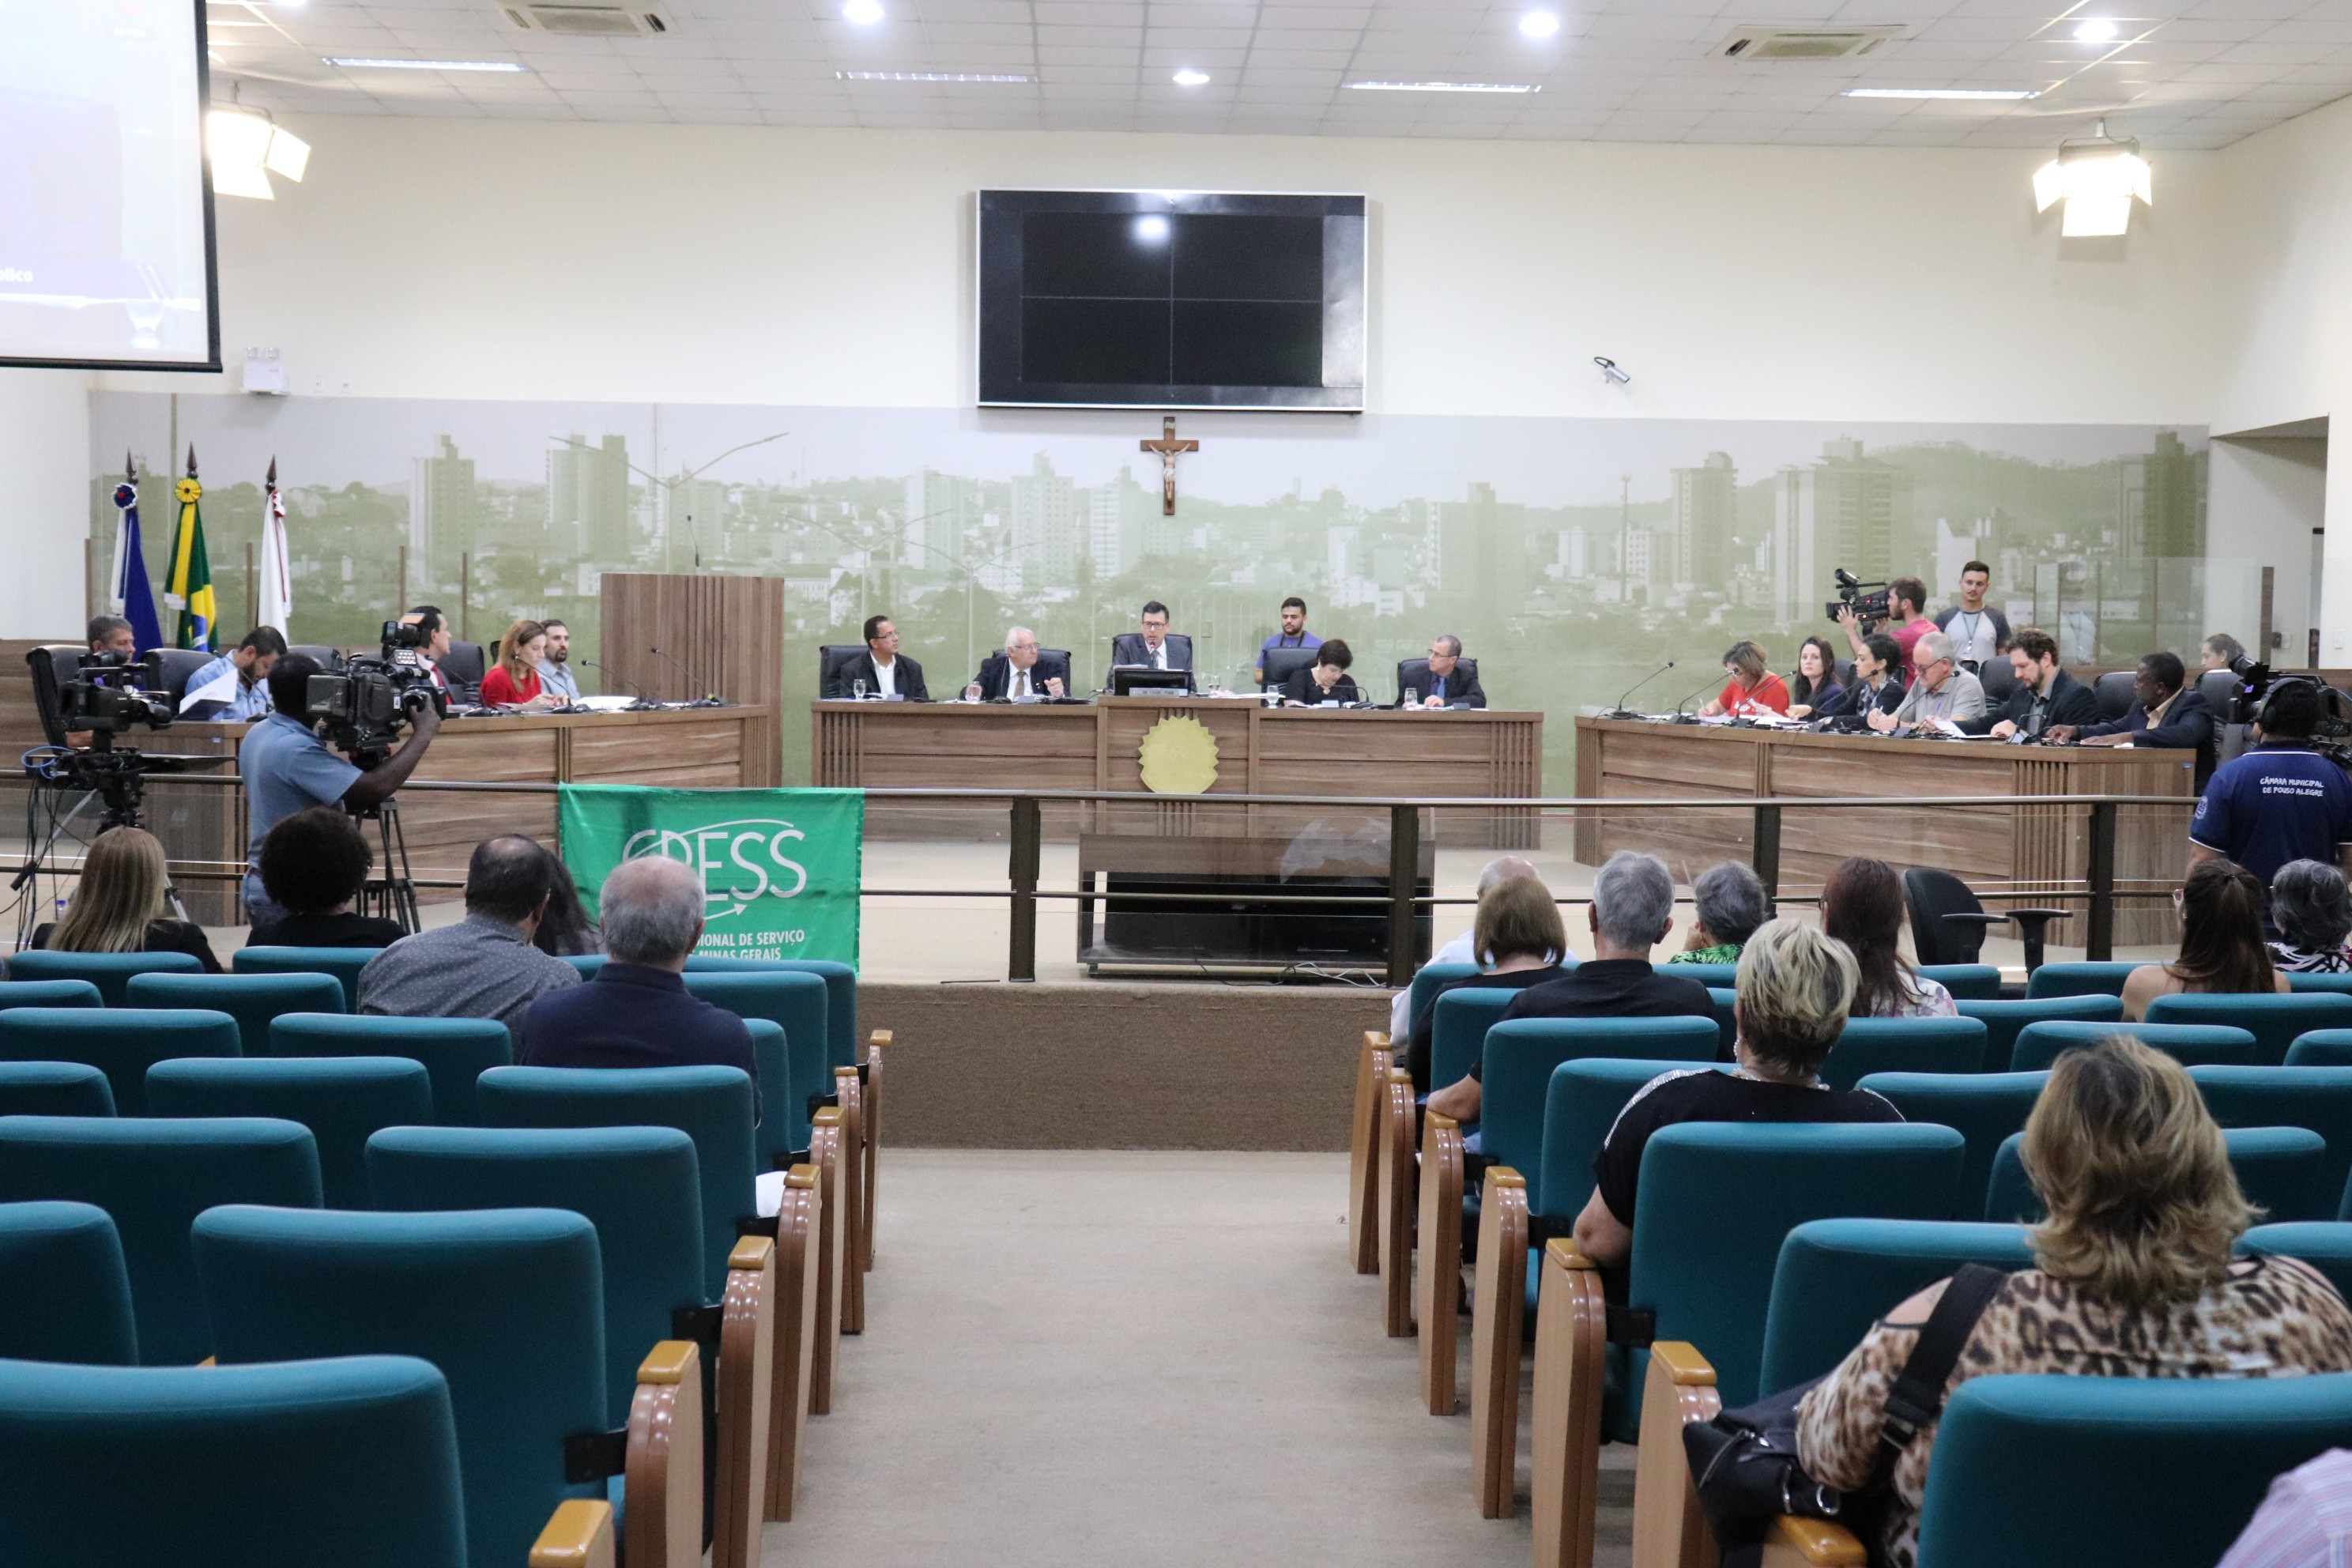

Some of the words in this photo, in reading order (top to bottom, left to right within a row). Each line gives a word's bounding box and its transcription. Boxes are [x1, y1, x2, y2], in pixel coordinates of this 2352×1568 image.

[2260, 776, 2287, 785] CÂMARA
[2288, 779, 2324, 788] MUNICIPAL
[2295, 788, 2324, 797] ALEGRE
[697, 933, 736, 947] IONAL
[739, 933, 753, 946] DE
[756, 929, 805, 946] SERVIÇO
[740, 948, 782, 960] GERAIS
